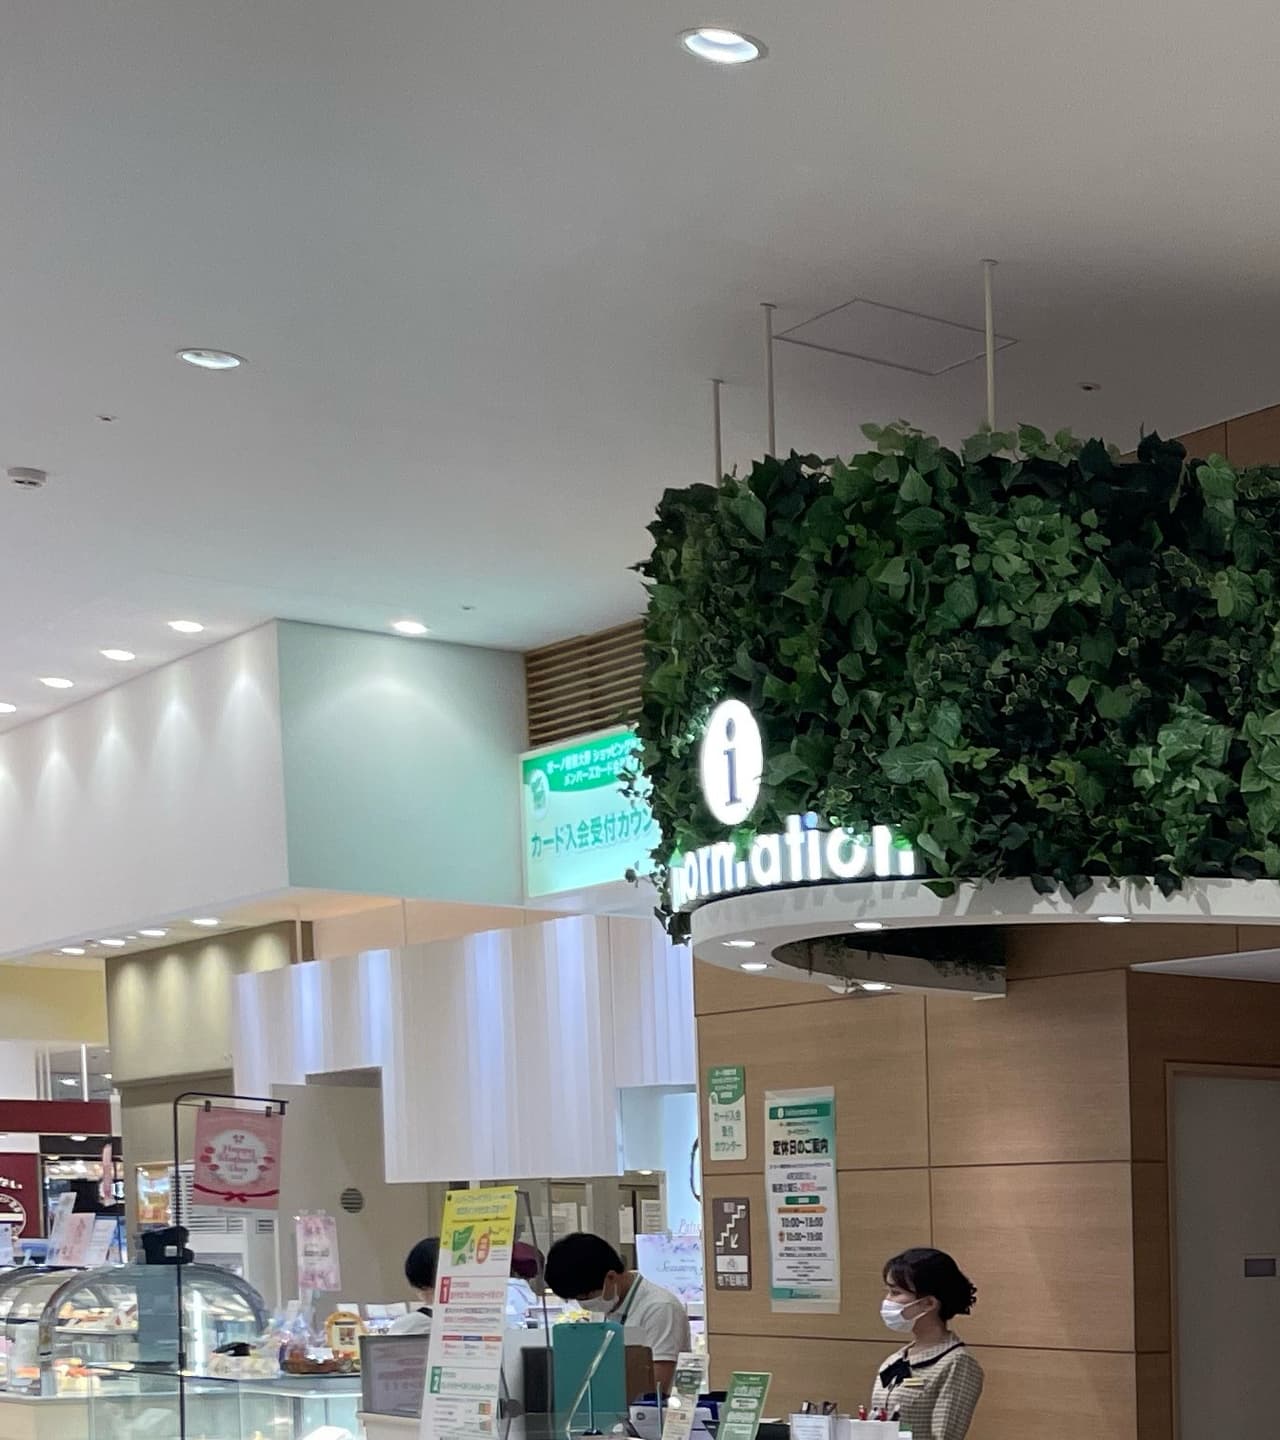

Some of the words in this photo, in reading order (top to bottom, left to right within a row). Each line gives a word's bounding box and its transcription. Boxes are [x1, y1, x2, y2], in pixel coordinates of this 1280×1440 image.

[531, 811, 652, 858] カード入会受付カウン
